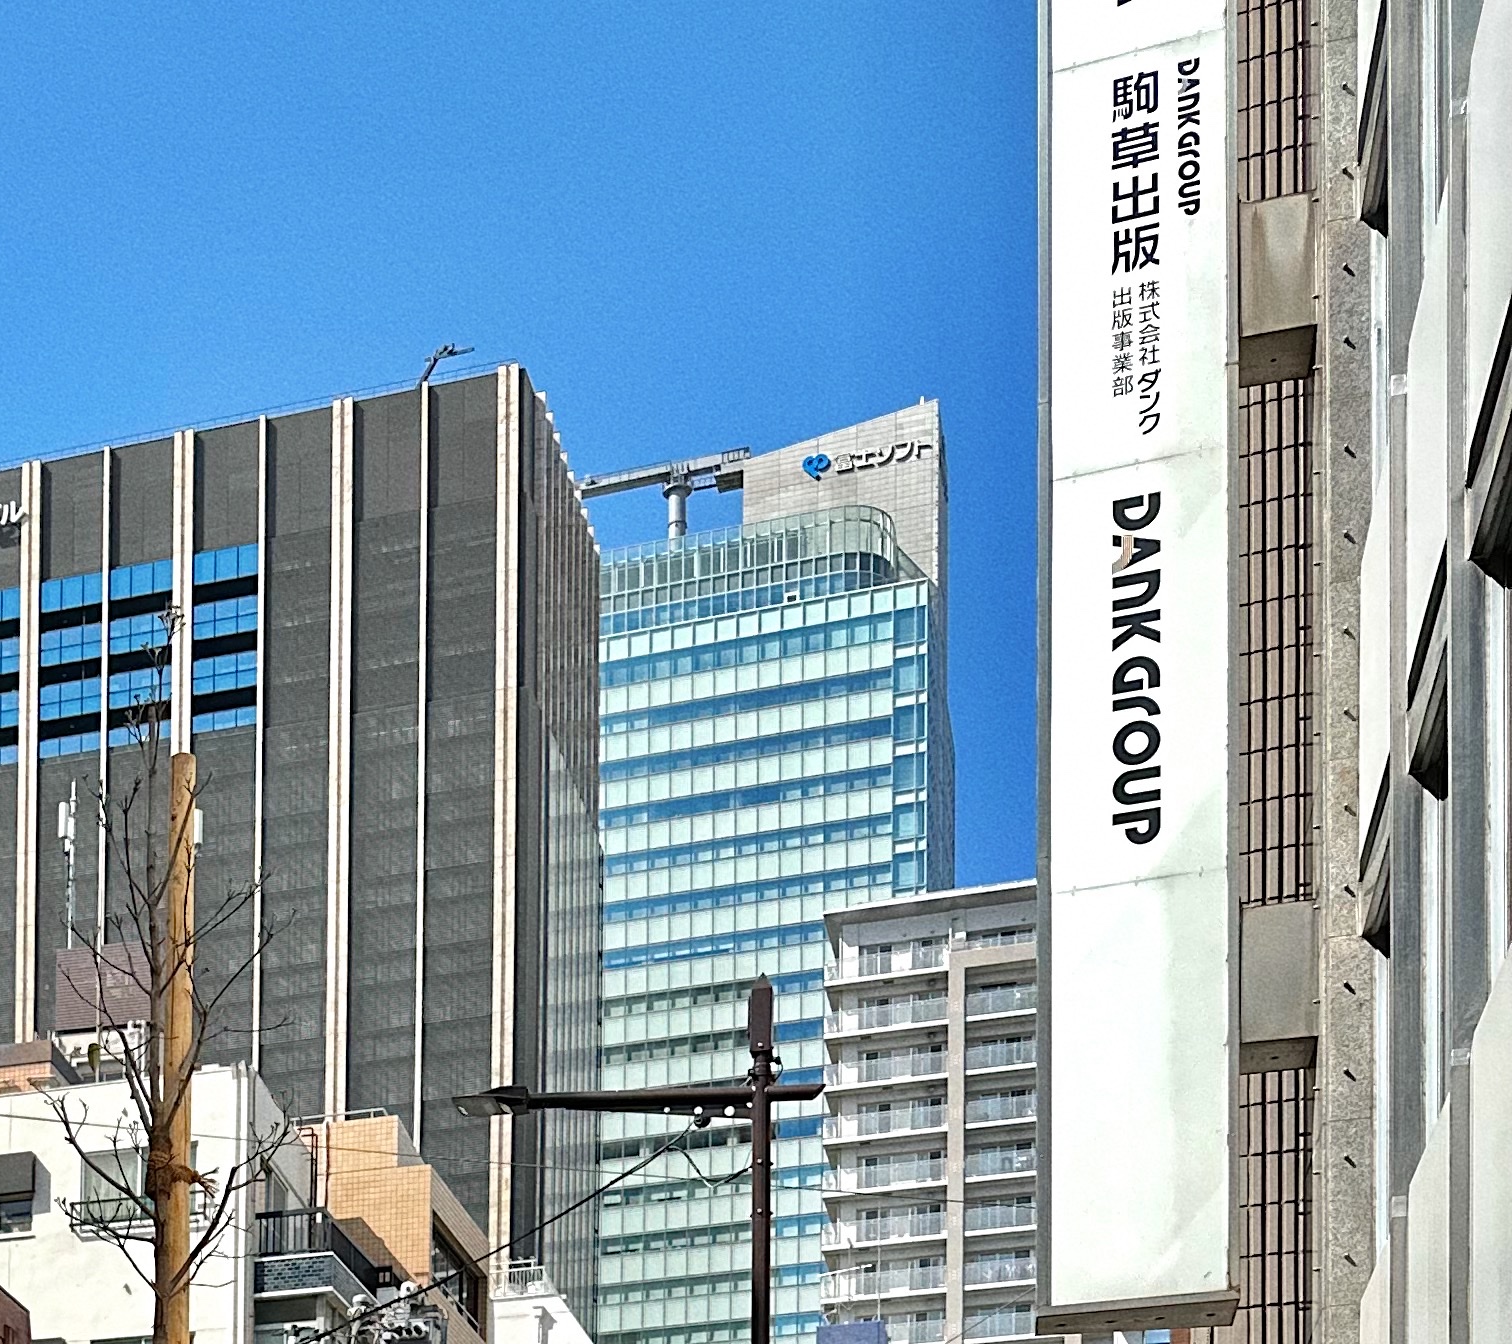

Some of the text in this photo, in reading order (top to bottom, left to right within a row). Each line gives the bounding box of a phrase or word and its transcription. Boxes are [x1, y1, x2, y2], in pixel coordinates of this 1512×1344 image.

[1111, 71, 1160, 275] 駒草出版
[1177, 131, 1201, 217] GROUP
[1111, 286, 1134, 398] 出版事業部
[834, 438, 933, 474] 富士ソフト
[1112, 491, 1161, 845] DANK GROUP
